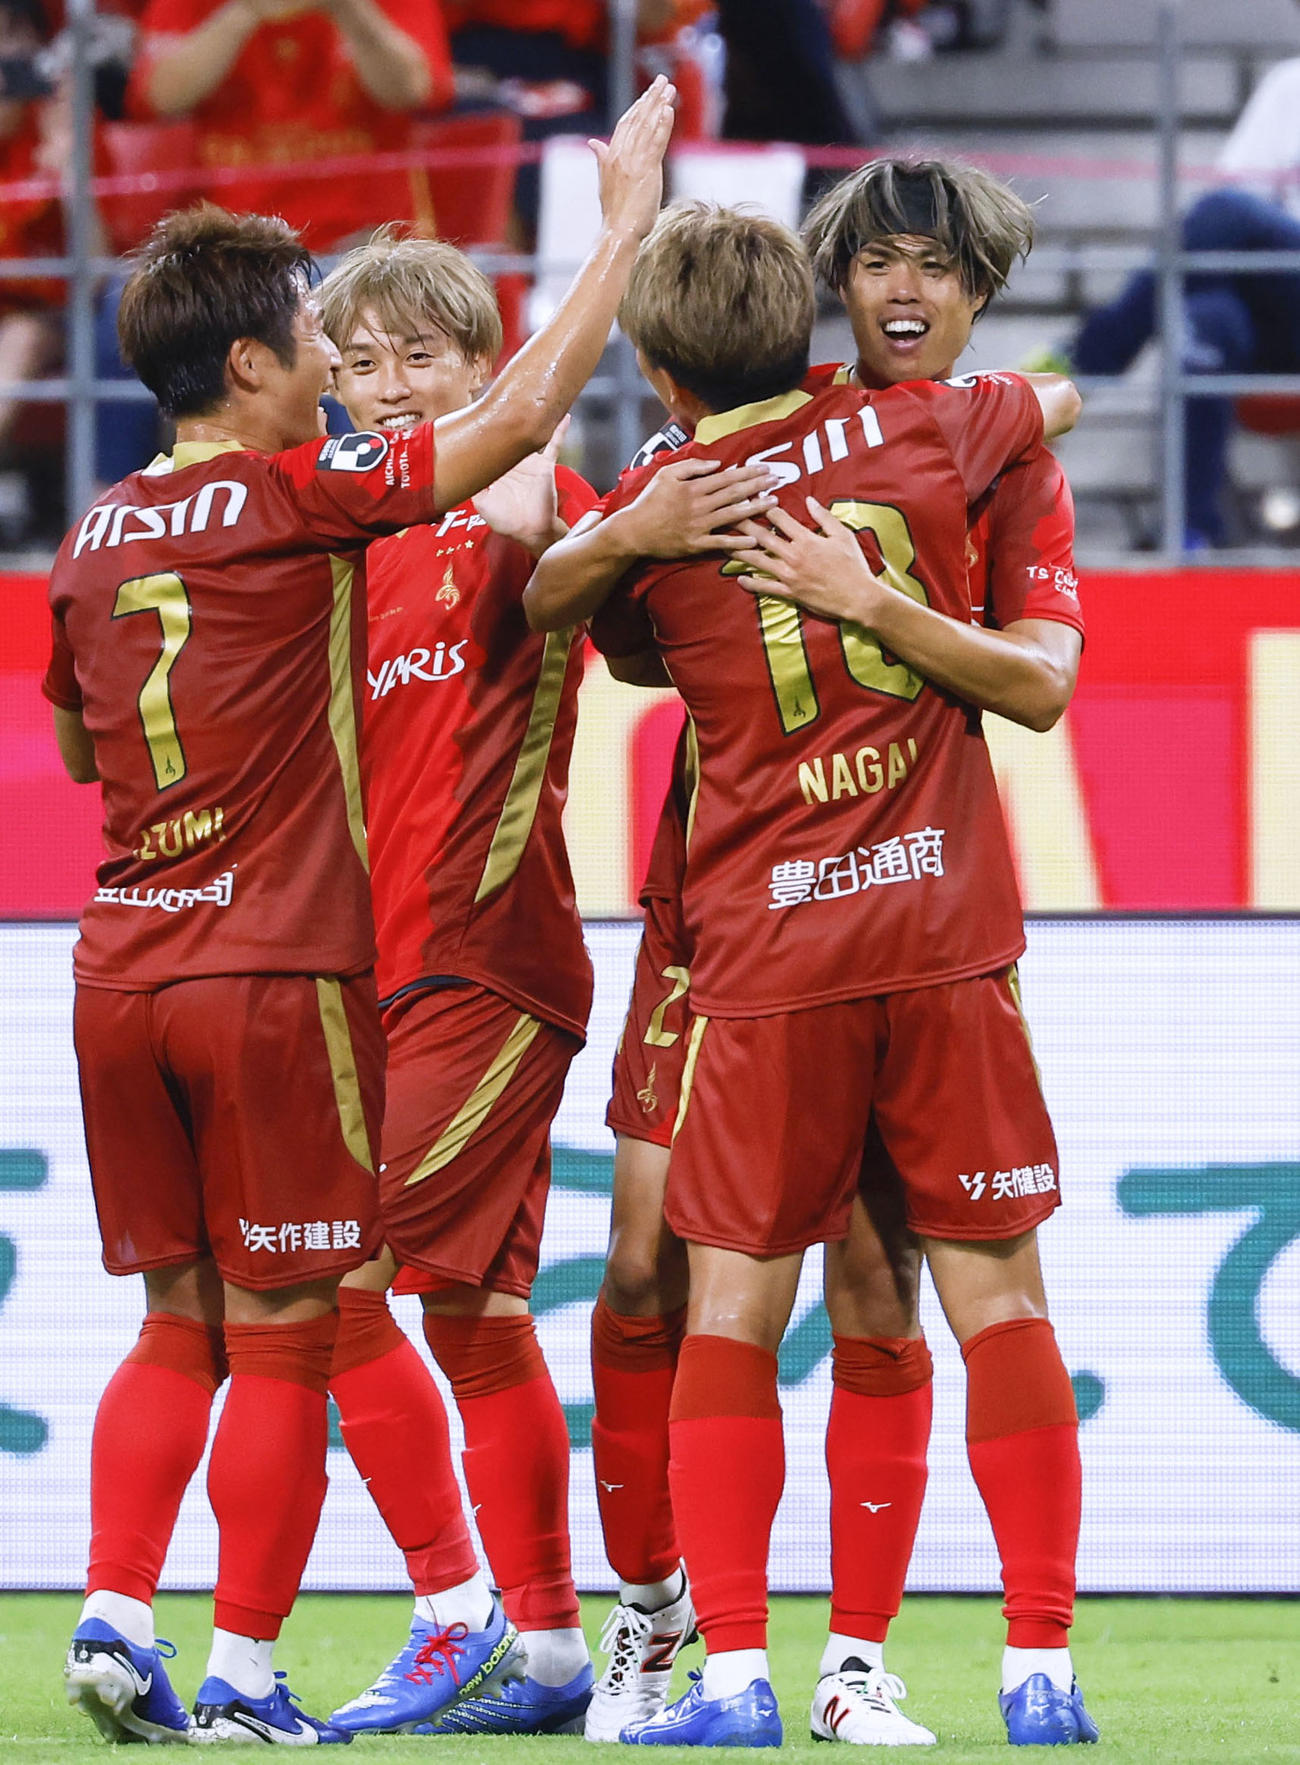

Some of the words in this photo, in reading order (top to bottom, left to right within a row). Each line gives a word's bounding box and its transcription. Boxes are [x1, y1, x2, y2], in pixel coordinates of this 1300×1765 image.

[724, 404, 885, 500] SIN
[73, 480, 248, 560] AISIN
[1025, 565, 1049, 580] TS
[111, 570, 192, 793] 7
[133, 807, 227, 860] ZUMI
[767, 826, 946, 910] 豊田通商
[248, 1220, 362, 1254] 矢作建設
[459, 1671, 483, 1695] new
